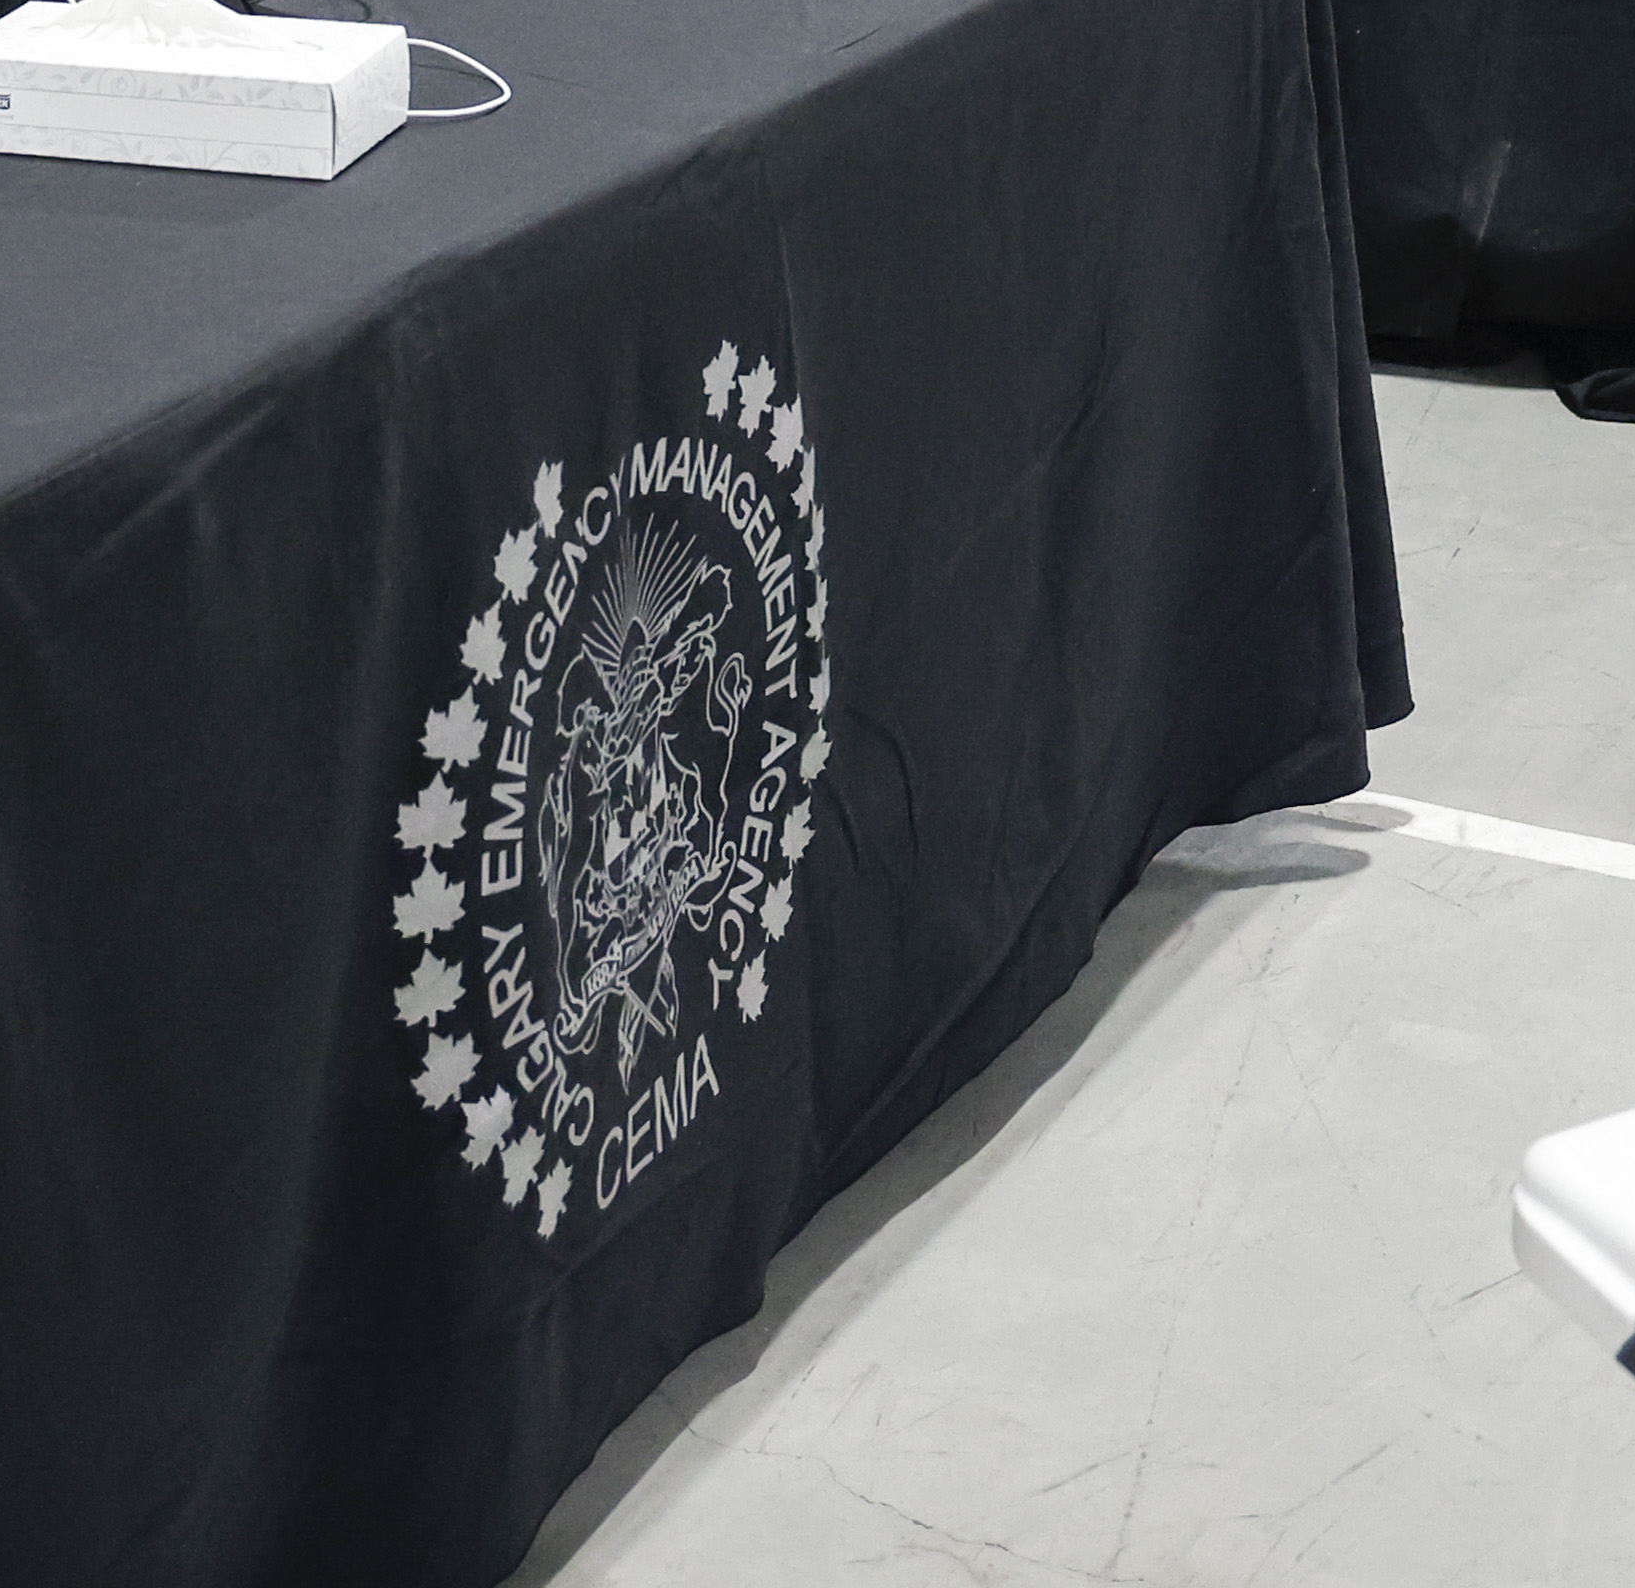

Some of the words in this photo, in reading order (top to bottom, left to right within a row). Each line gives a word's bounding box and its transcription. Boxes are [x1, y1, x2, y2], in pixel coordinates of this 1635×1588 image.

[480, 454, 626, 898] EMERGENCY
[629, 437, 798, 700] MANAGEMENT
[707, 720, 798, 1011] AGENCY
[481, 923, 595, 1147] CALGARY
[597, 1034, 720, 1211] CEMA
